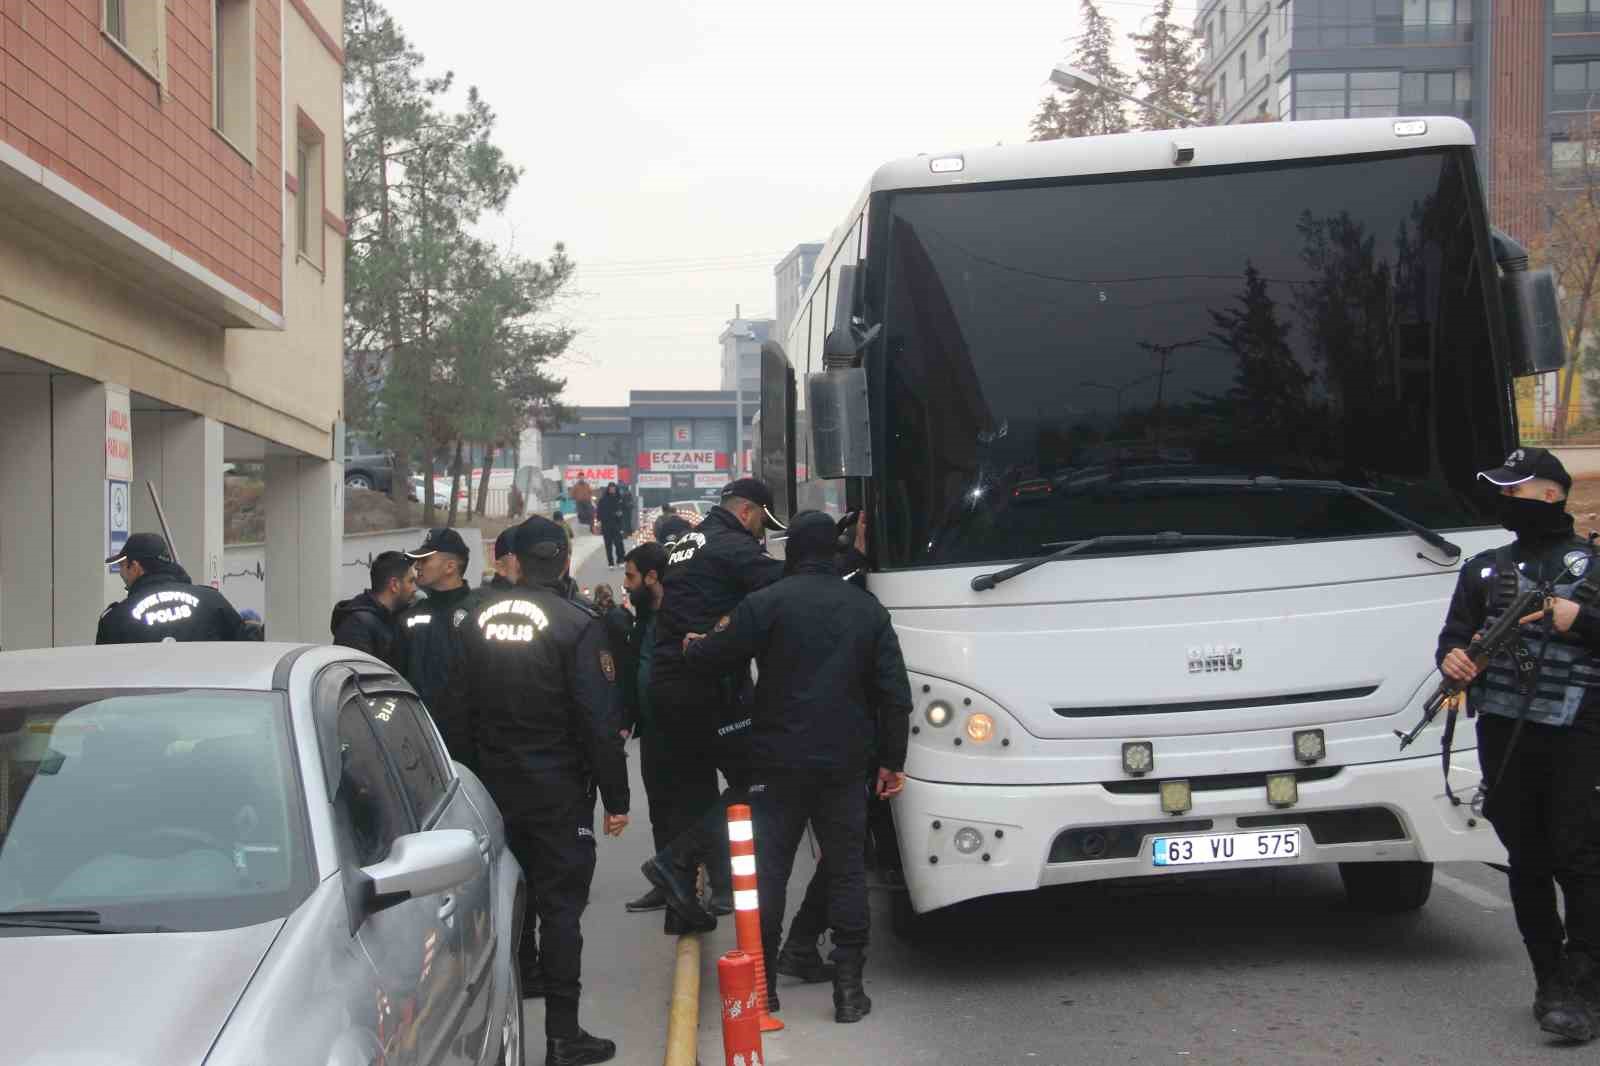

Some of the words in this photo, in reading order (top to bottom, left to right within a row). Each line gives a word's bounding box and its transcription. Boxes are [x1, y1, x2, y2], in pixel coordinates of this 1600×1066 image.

[652, 452, 713, 464] ECZANE
[1168, 841, 1193, 861] 63
[1210, 837, 1234, 858] VU
[1257, 833, 1295, 856] 575
